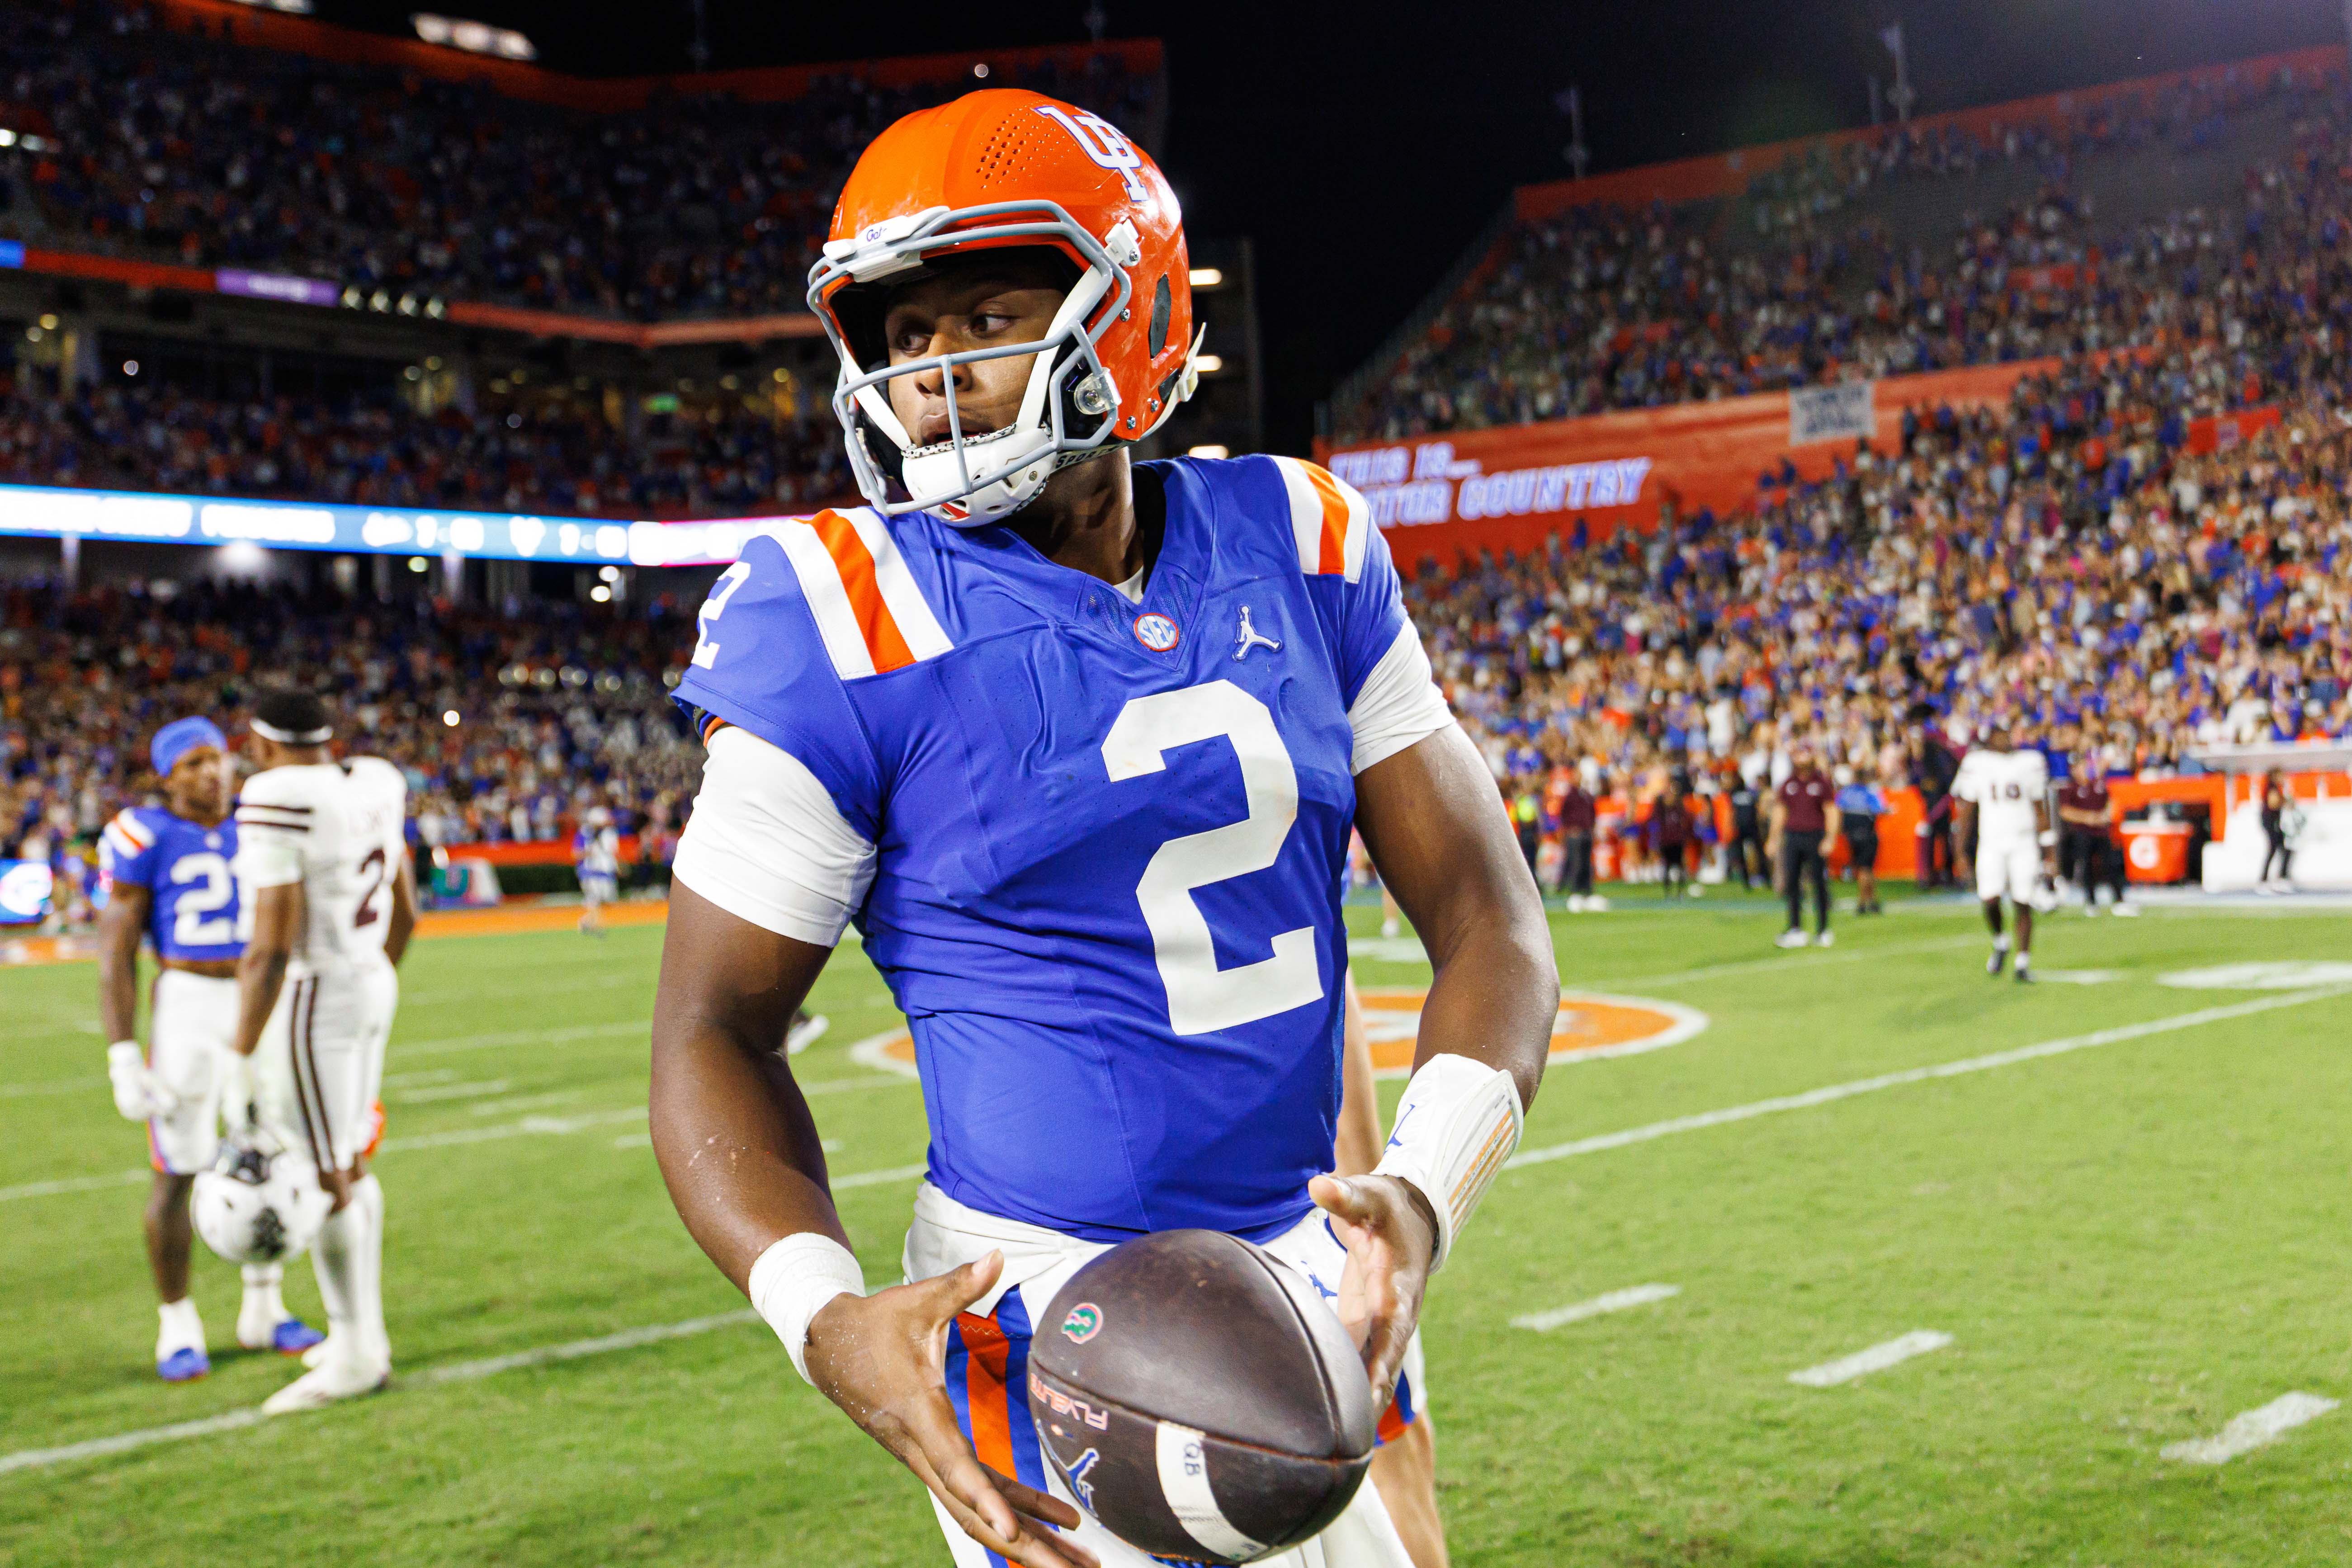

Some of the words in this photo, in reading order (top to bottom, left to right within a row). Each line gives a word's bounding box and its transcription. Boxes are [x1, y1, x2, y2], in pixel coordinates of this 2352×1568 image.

[1328, 446, 1410, 486] THIS
[1457, 456, 1652, 521] COUNTRY
[691, 561, 751, 670] 2
[1138, 615, 1176, 649] SEC
[354, 847, 386, 928] 2
[1100, 679, 1325, 1036] 2
[1183, 1442, 1201, 1476] QB
